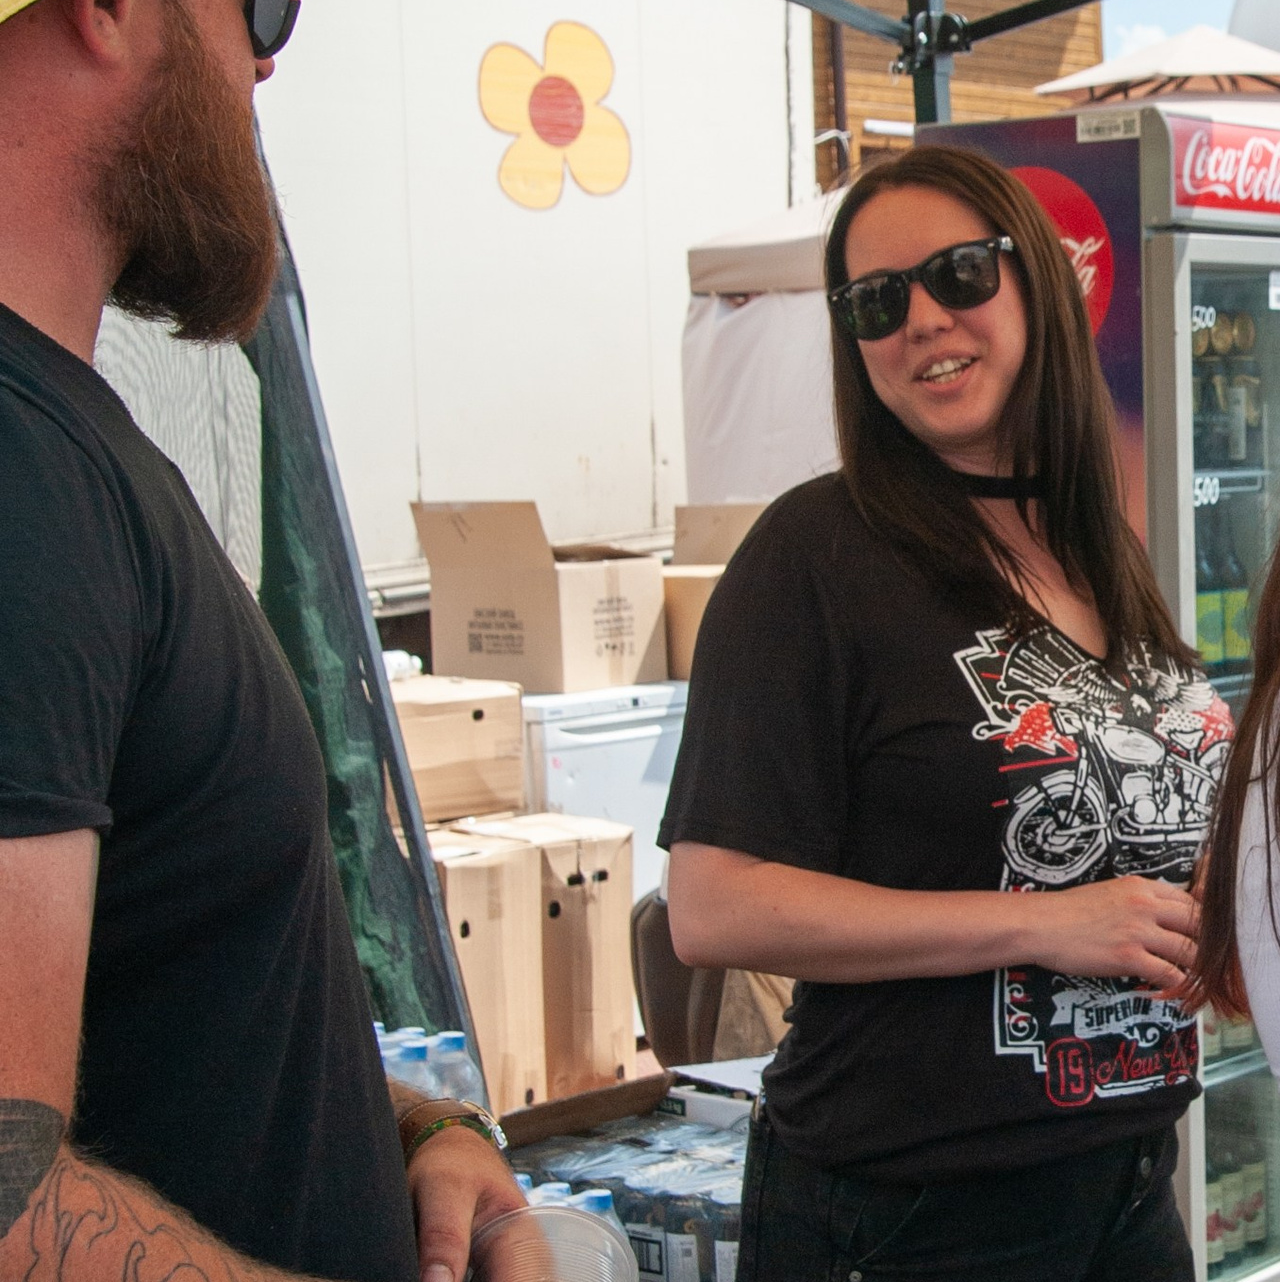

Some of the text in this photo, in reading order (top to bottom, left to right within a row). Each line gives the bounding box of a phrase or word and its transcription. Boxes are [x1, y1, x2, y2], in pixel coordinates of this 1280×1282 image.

[1192, 305, 1216, 332] 500
[1194, 476, 1220, 507] 500
[1057, 1048, 1085, 1096] 19
